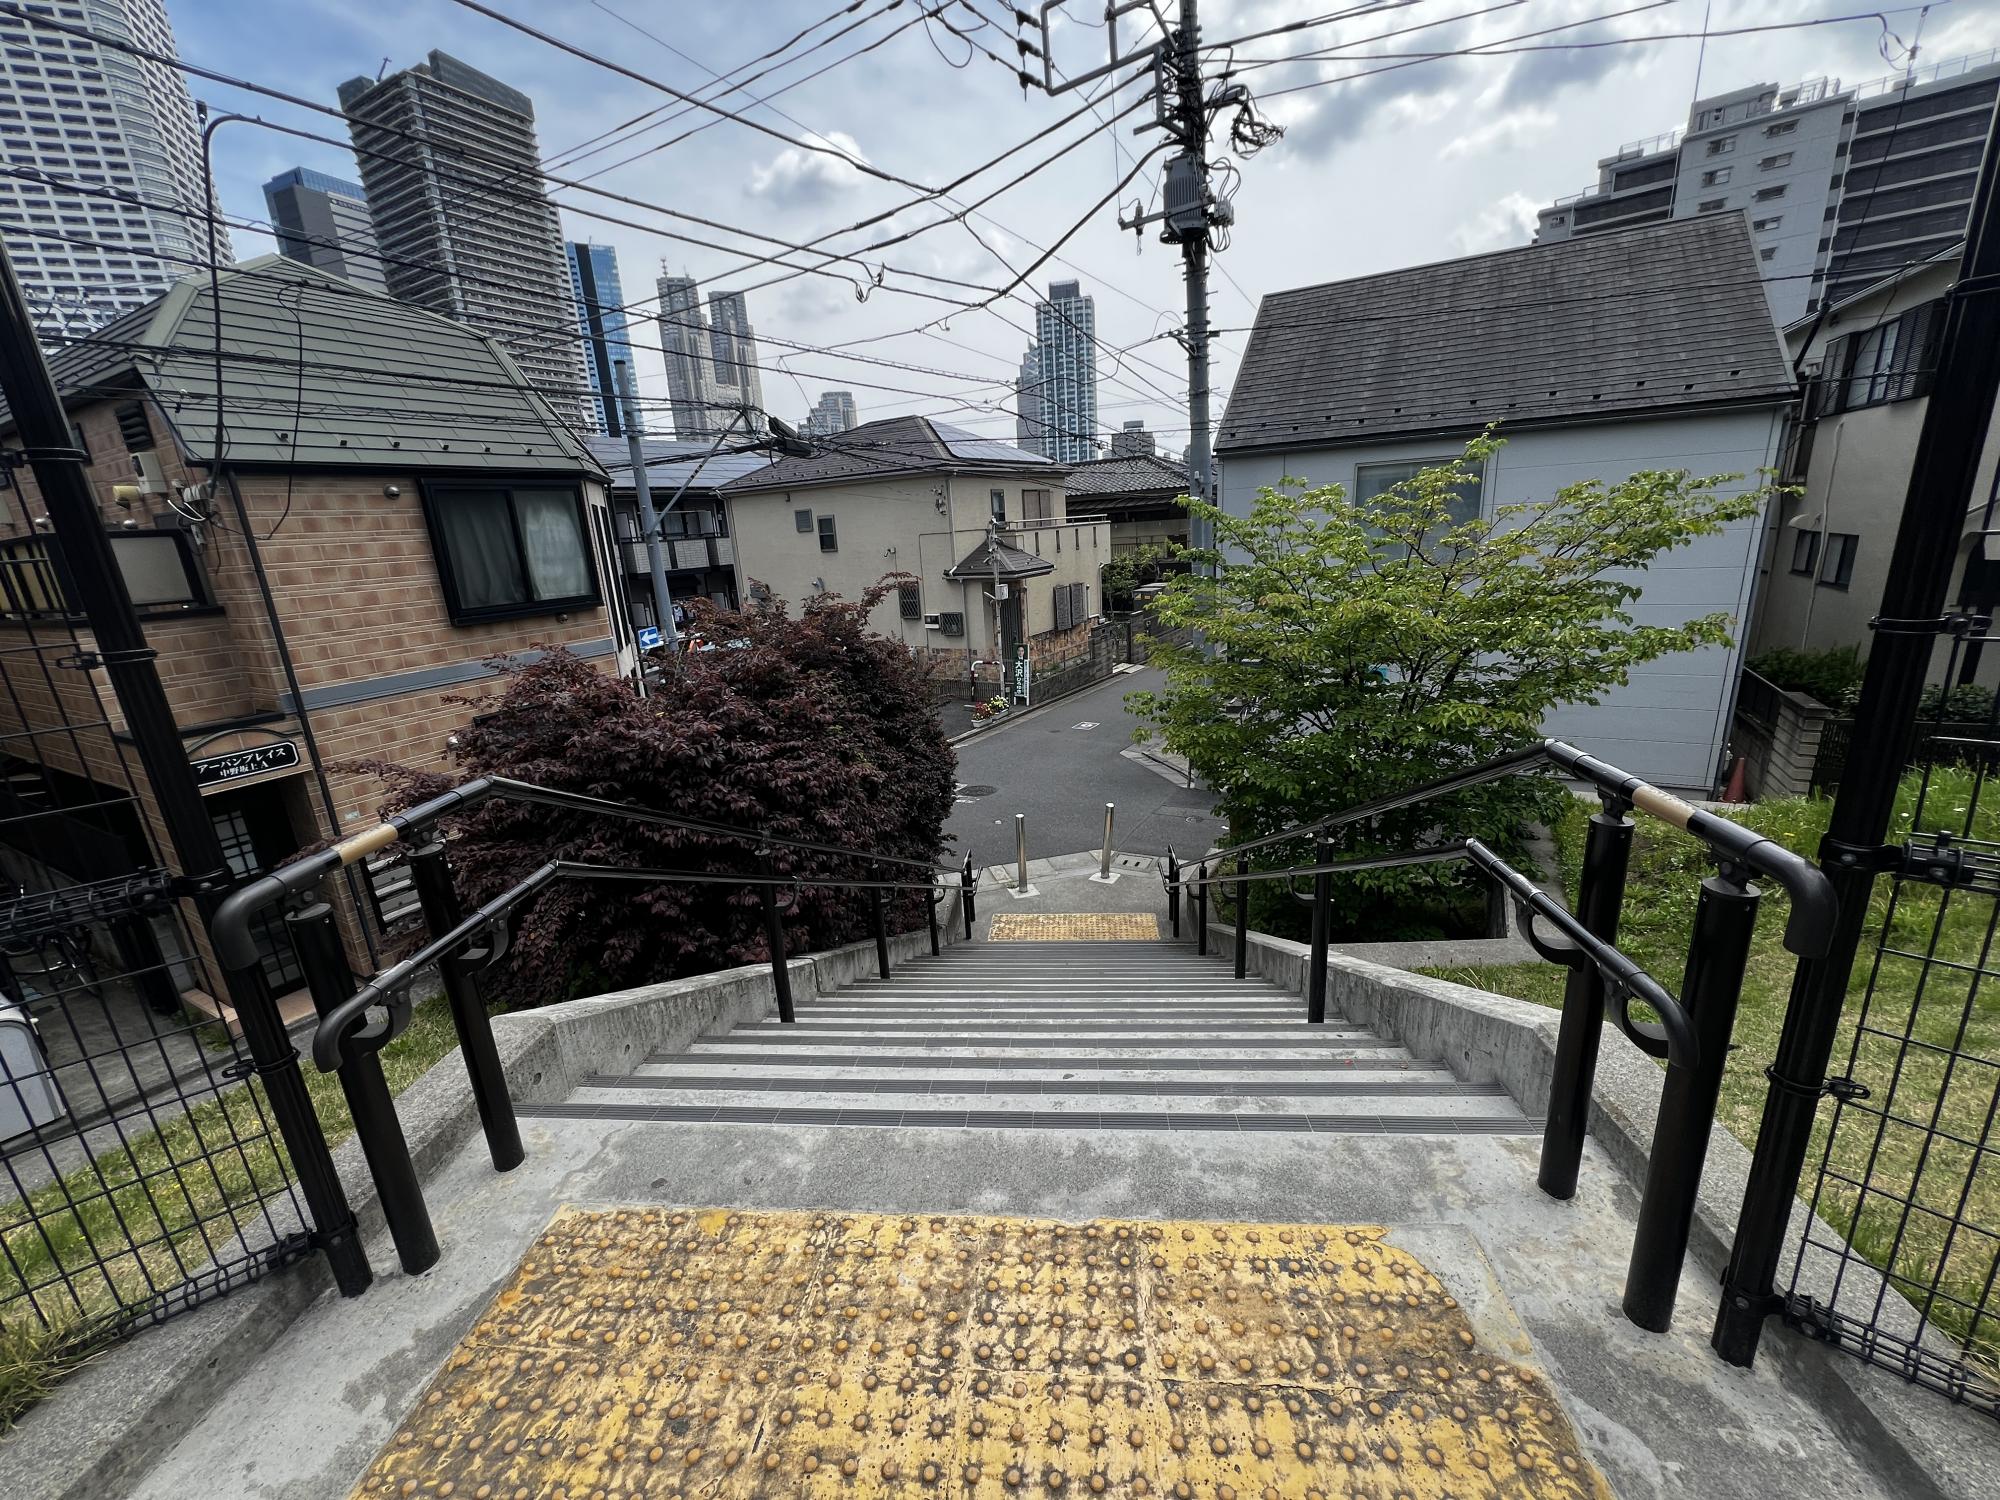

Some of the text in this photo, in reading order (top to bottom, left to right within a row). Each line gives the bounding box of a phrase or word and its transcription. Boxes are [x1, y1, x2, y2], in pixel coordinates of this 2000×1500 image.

[197, 748, 286, 774] アーバンプレイス
